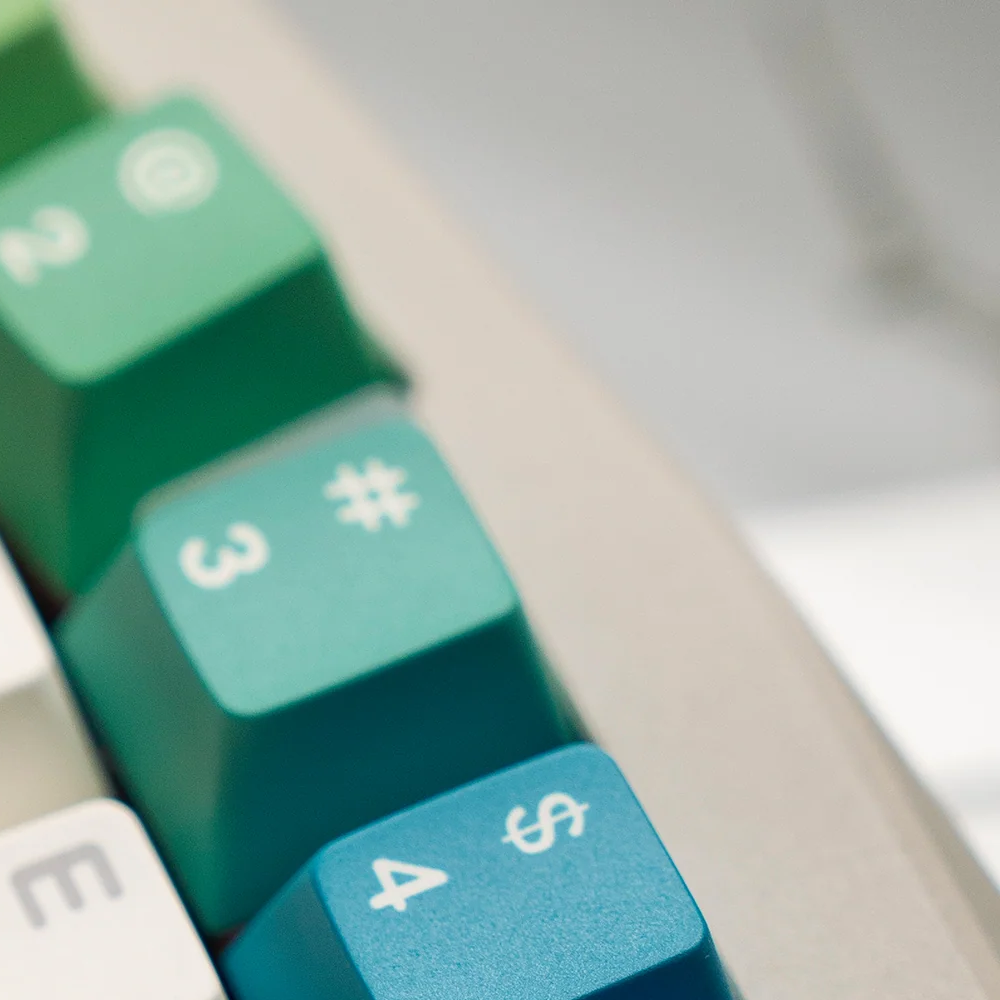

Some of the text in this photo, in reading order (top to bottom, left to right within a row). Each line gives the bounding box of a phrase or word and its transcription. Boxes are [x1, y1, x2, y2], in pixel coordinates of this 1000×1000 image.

[117, 128, 219, 216] @
[325, 458, 420, 531] #
[179, 523, 269, 589] 3
[501, 792, 588, 854] $
[9, 842, 124, 930] E
[369, 857, 448, 911] 4
